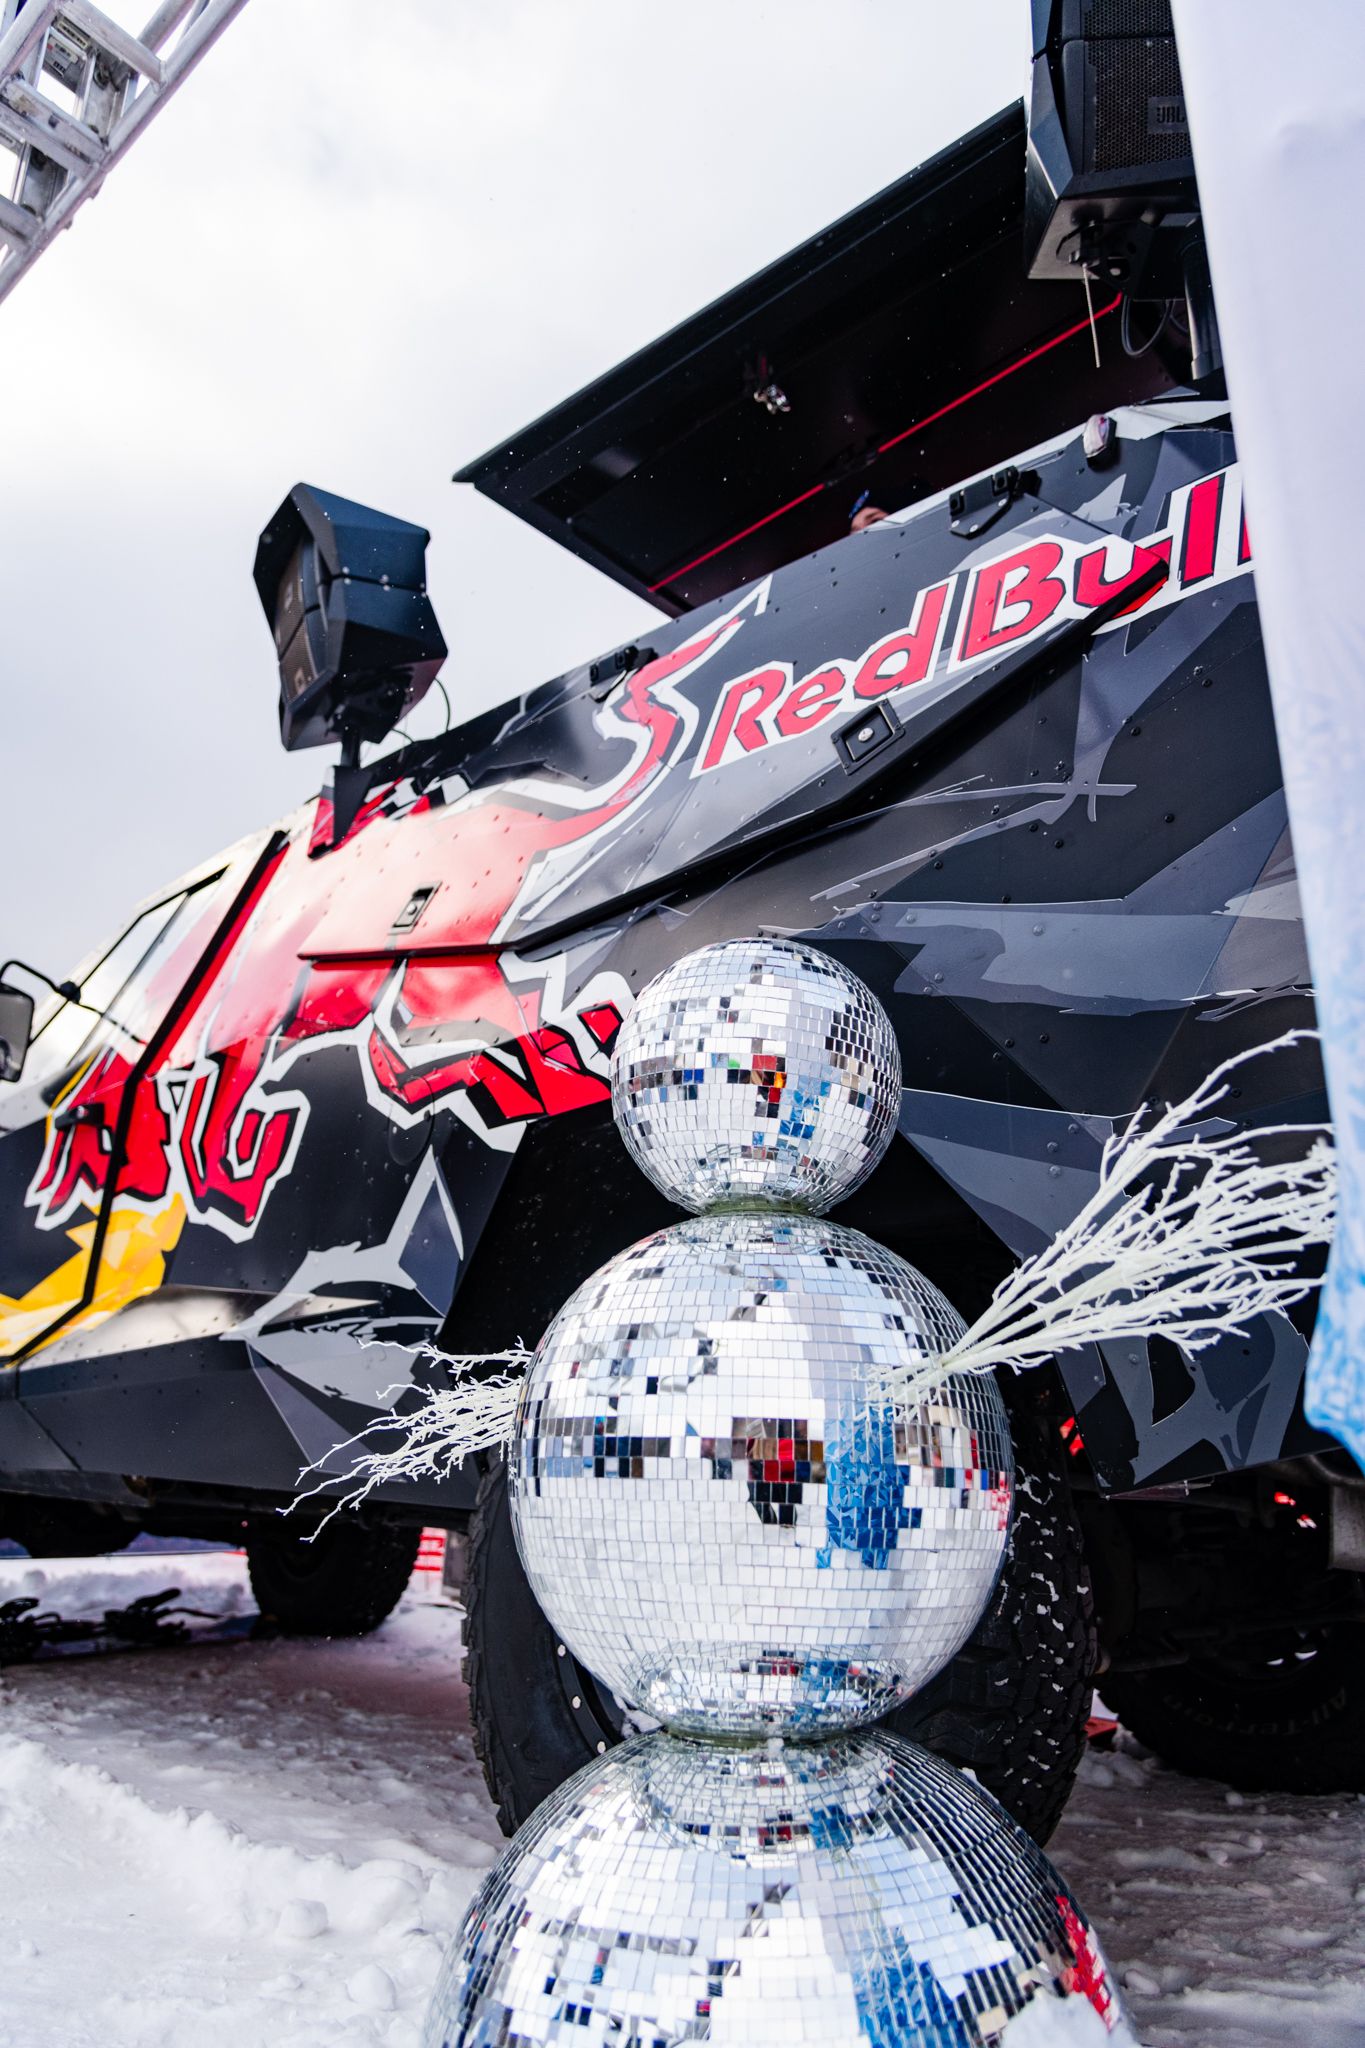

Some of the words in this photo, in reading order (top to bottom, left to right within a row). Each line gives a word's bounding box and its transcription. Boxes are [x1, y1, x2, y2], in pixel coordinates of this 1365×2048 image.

[1156, 105, 1185, 123] JBL
[698, 576, 954, 774] Red
[955, 467, 1253, 664] Bul
